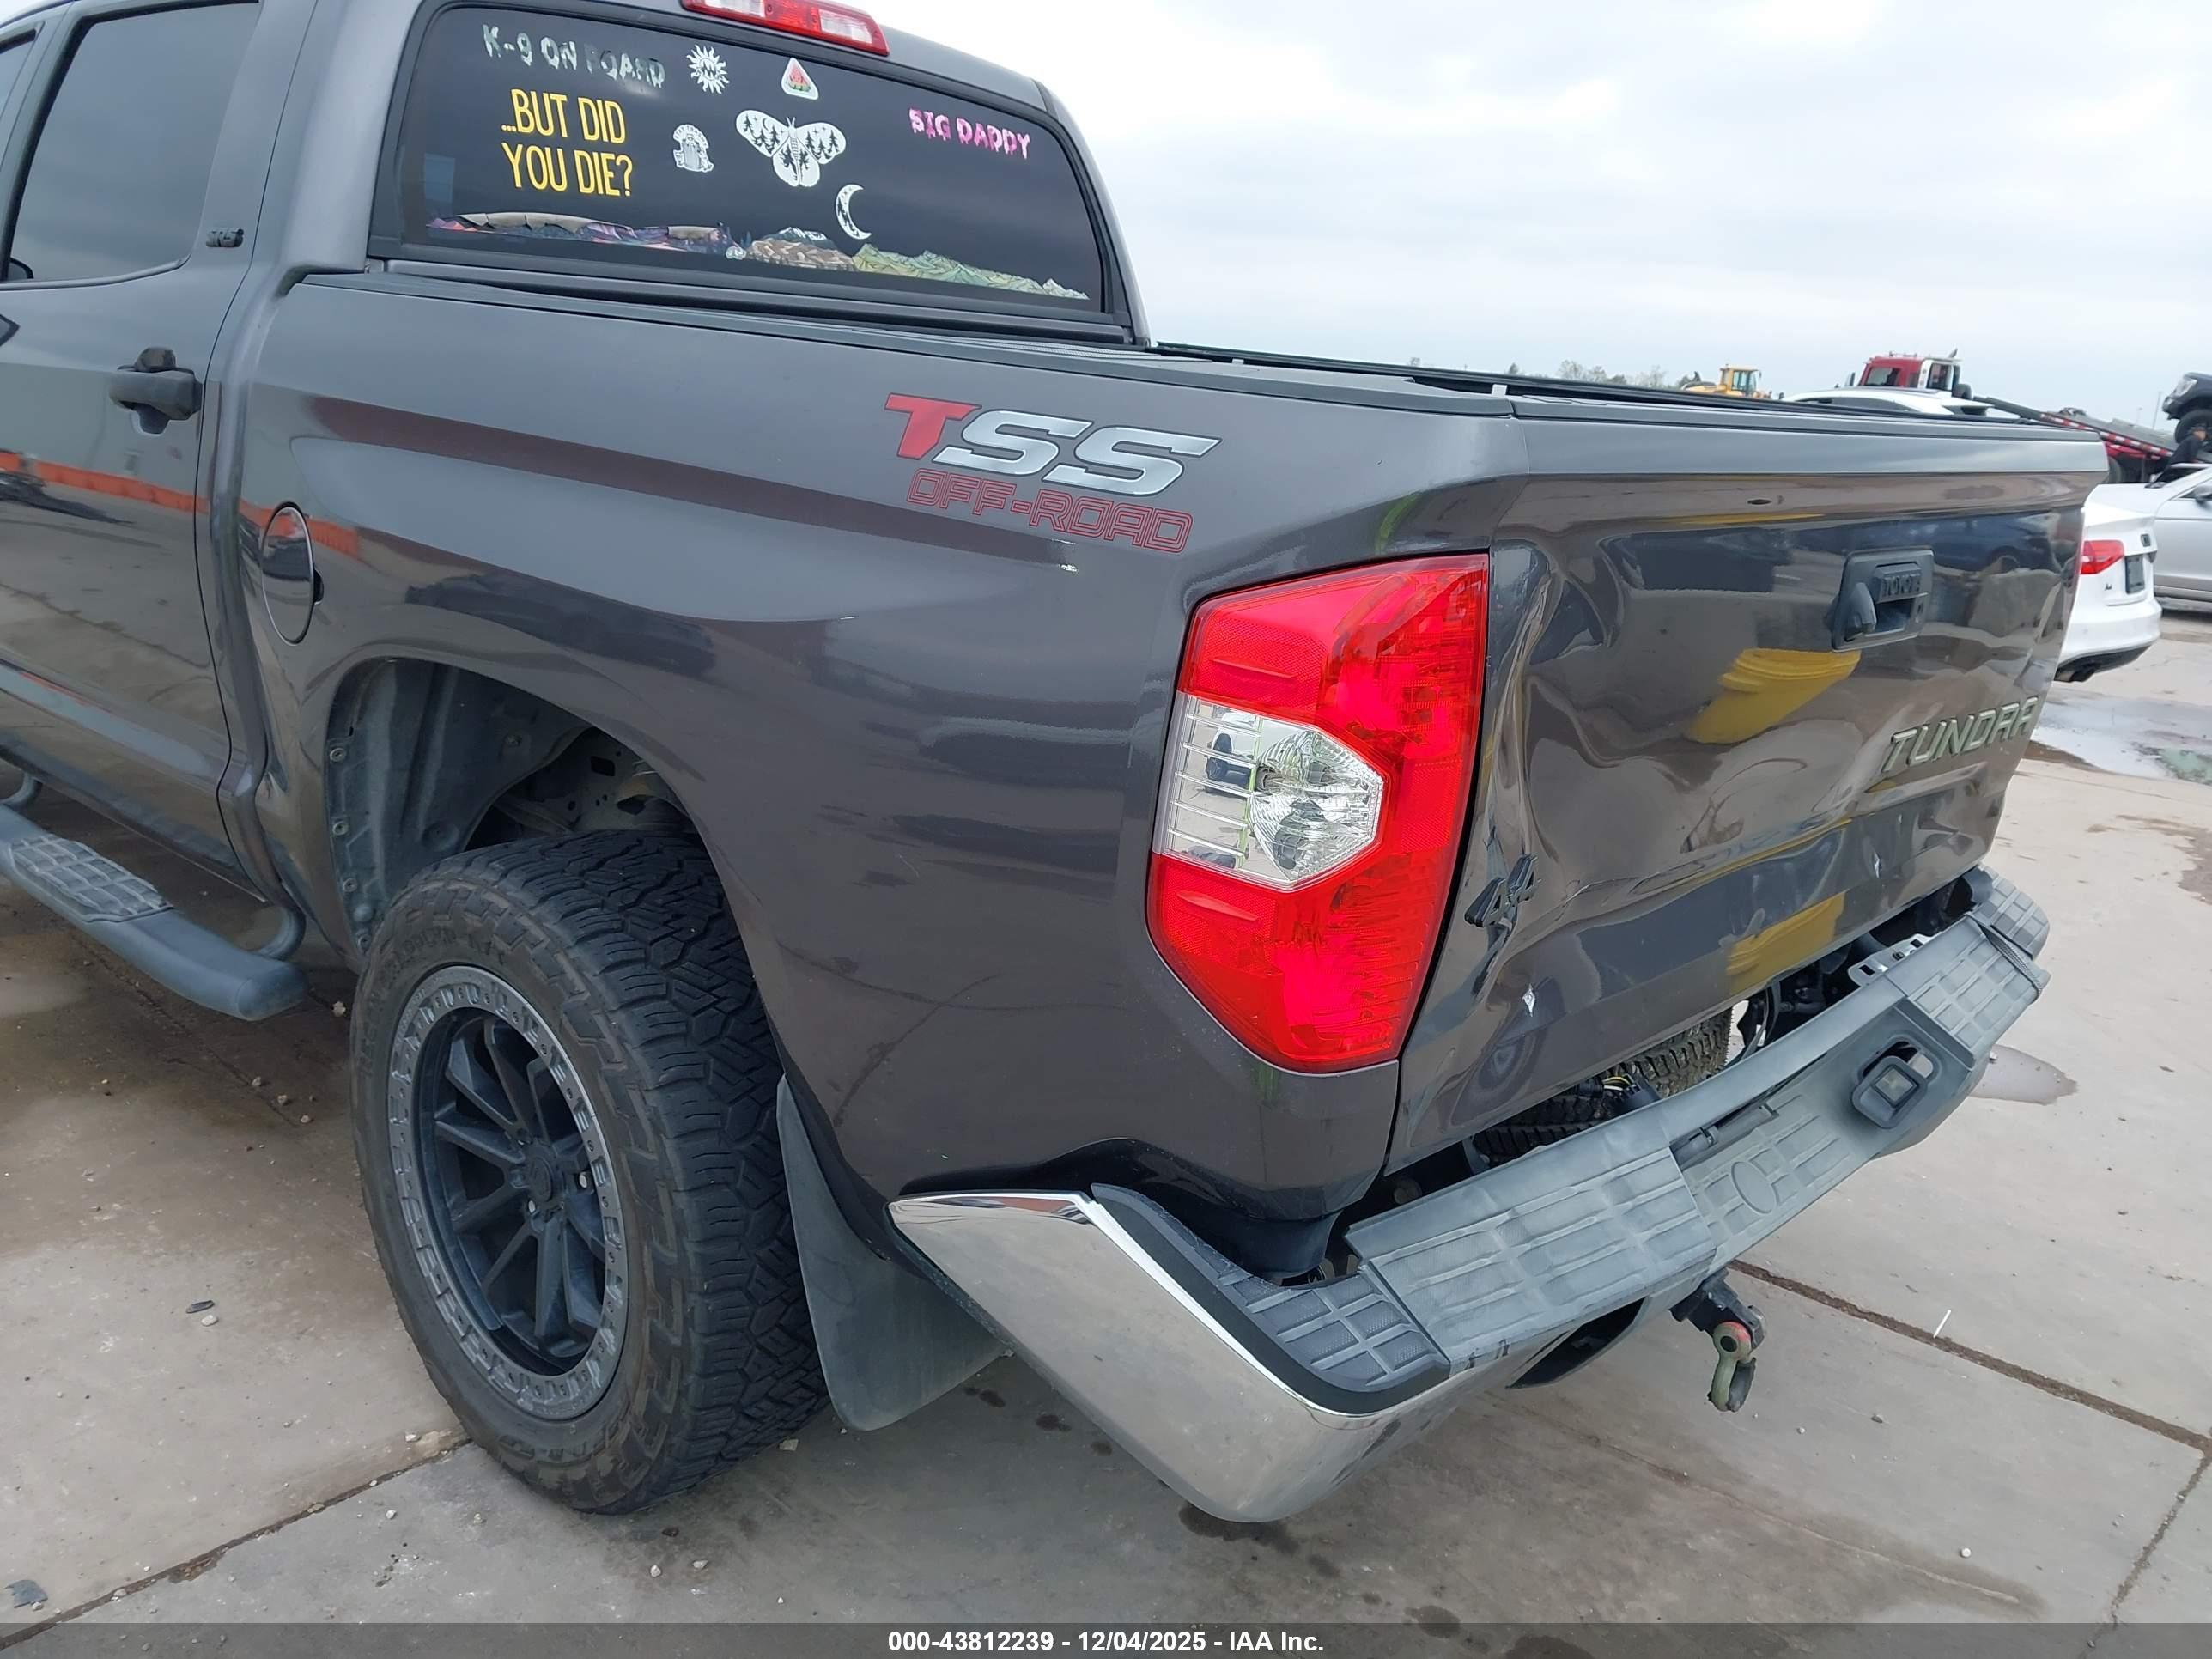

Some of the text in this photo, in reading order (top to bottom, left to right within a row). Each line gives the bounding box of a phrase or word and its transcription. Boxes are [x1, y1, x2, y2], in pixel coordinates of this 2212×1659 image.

[540, 36, 577, 70] ON
[577, 96, 626, 144] DID
[956, 117, 1030, 160] DADDY
[501, 141, 634, 198] YOU DIE?
[884, 392, 1222, 497] TSS
[906, 468, 1194, 554] OFF-ROAD
[1880, 695, 2040, 775] TUNDRA
